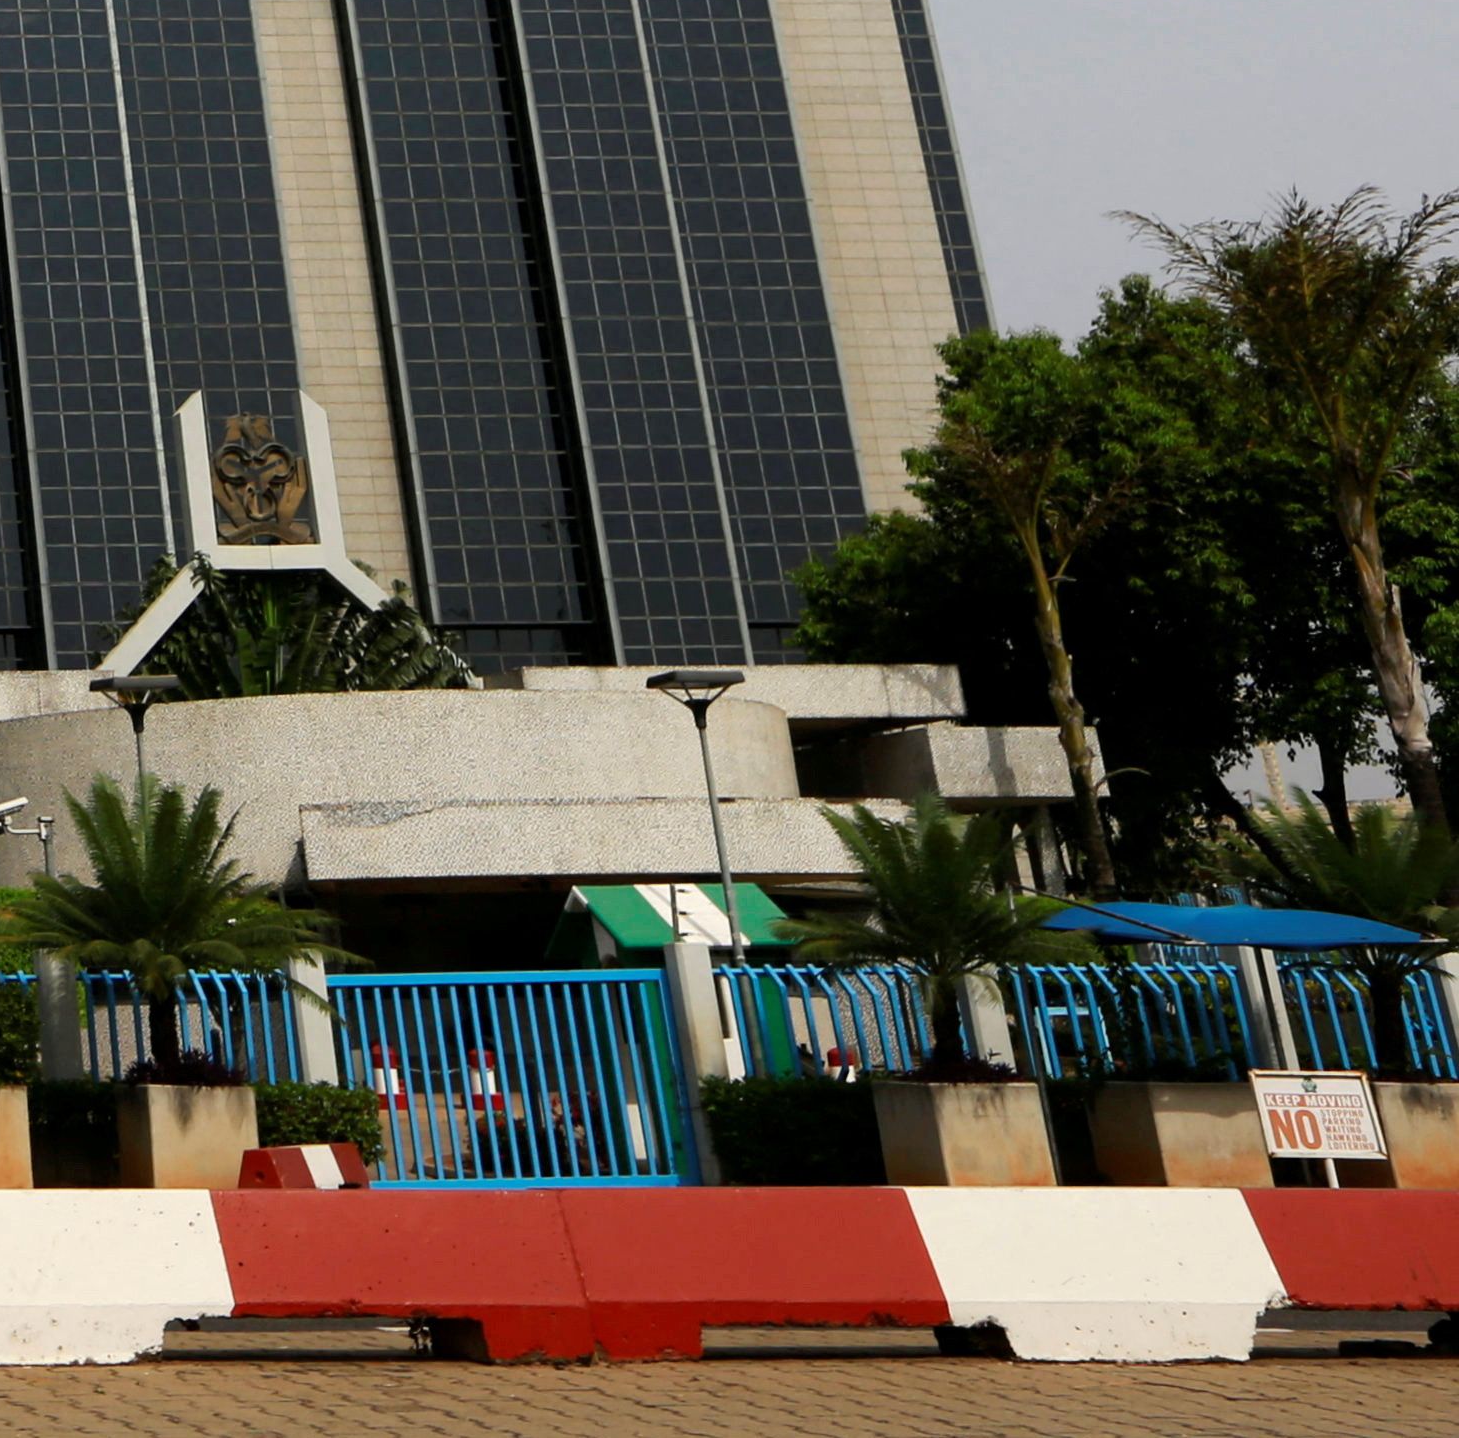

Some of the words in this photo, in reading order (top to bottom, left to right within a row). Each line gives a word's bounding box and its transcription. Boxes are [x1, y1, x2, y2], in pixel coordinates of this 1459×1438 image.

[1265, 1094, 1301, 1106] KEEP
[1305, 1095, 1362, 1107] MOVING
[1320, 1109, 1364, 1118] STOPPING
[1322, 1117, 1362, 1126] PARKING
[1268, 1109, 1322, 1150] NO
[1324, 1125, 1362, 1134] WAITING
[1326, 1133, 1368, 1142] HAWKING
[1328, 1141, 1375, 1150] LOITERING
